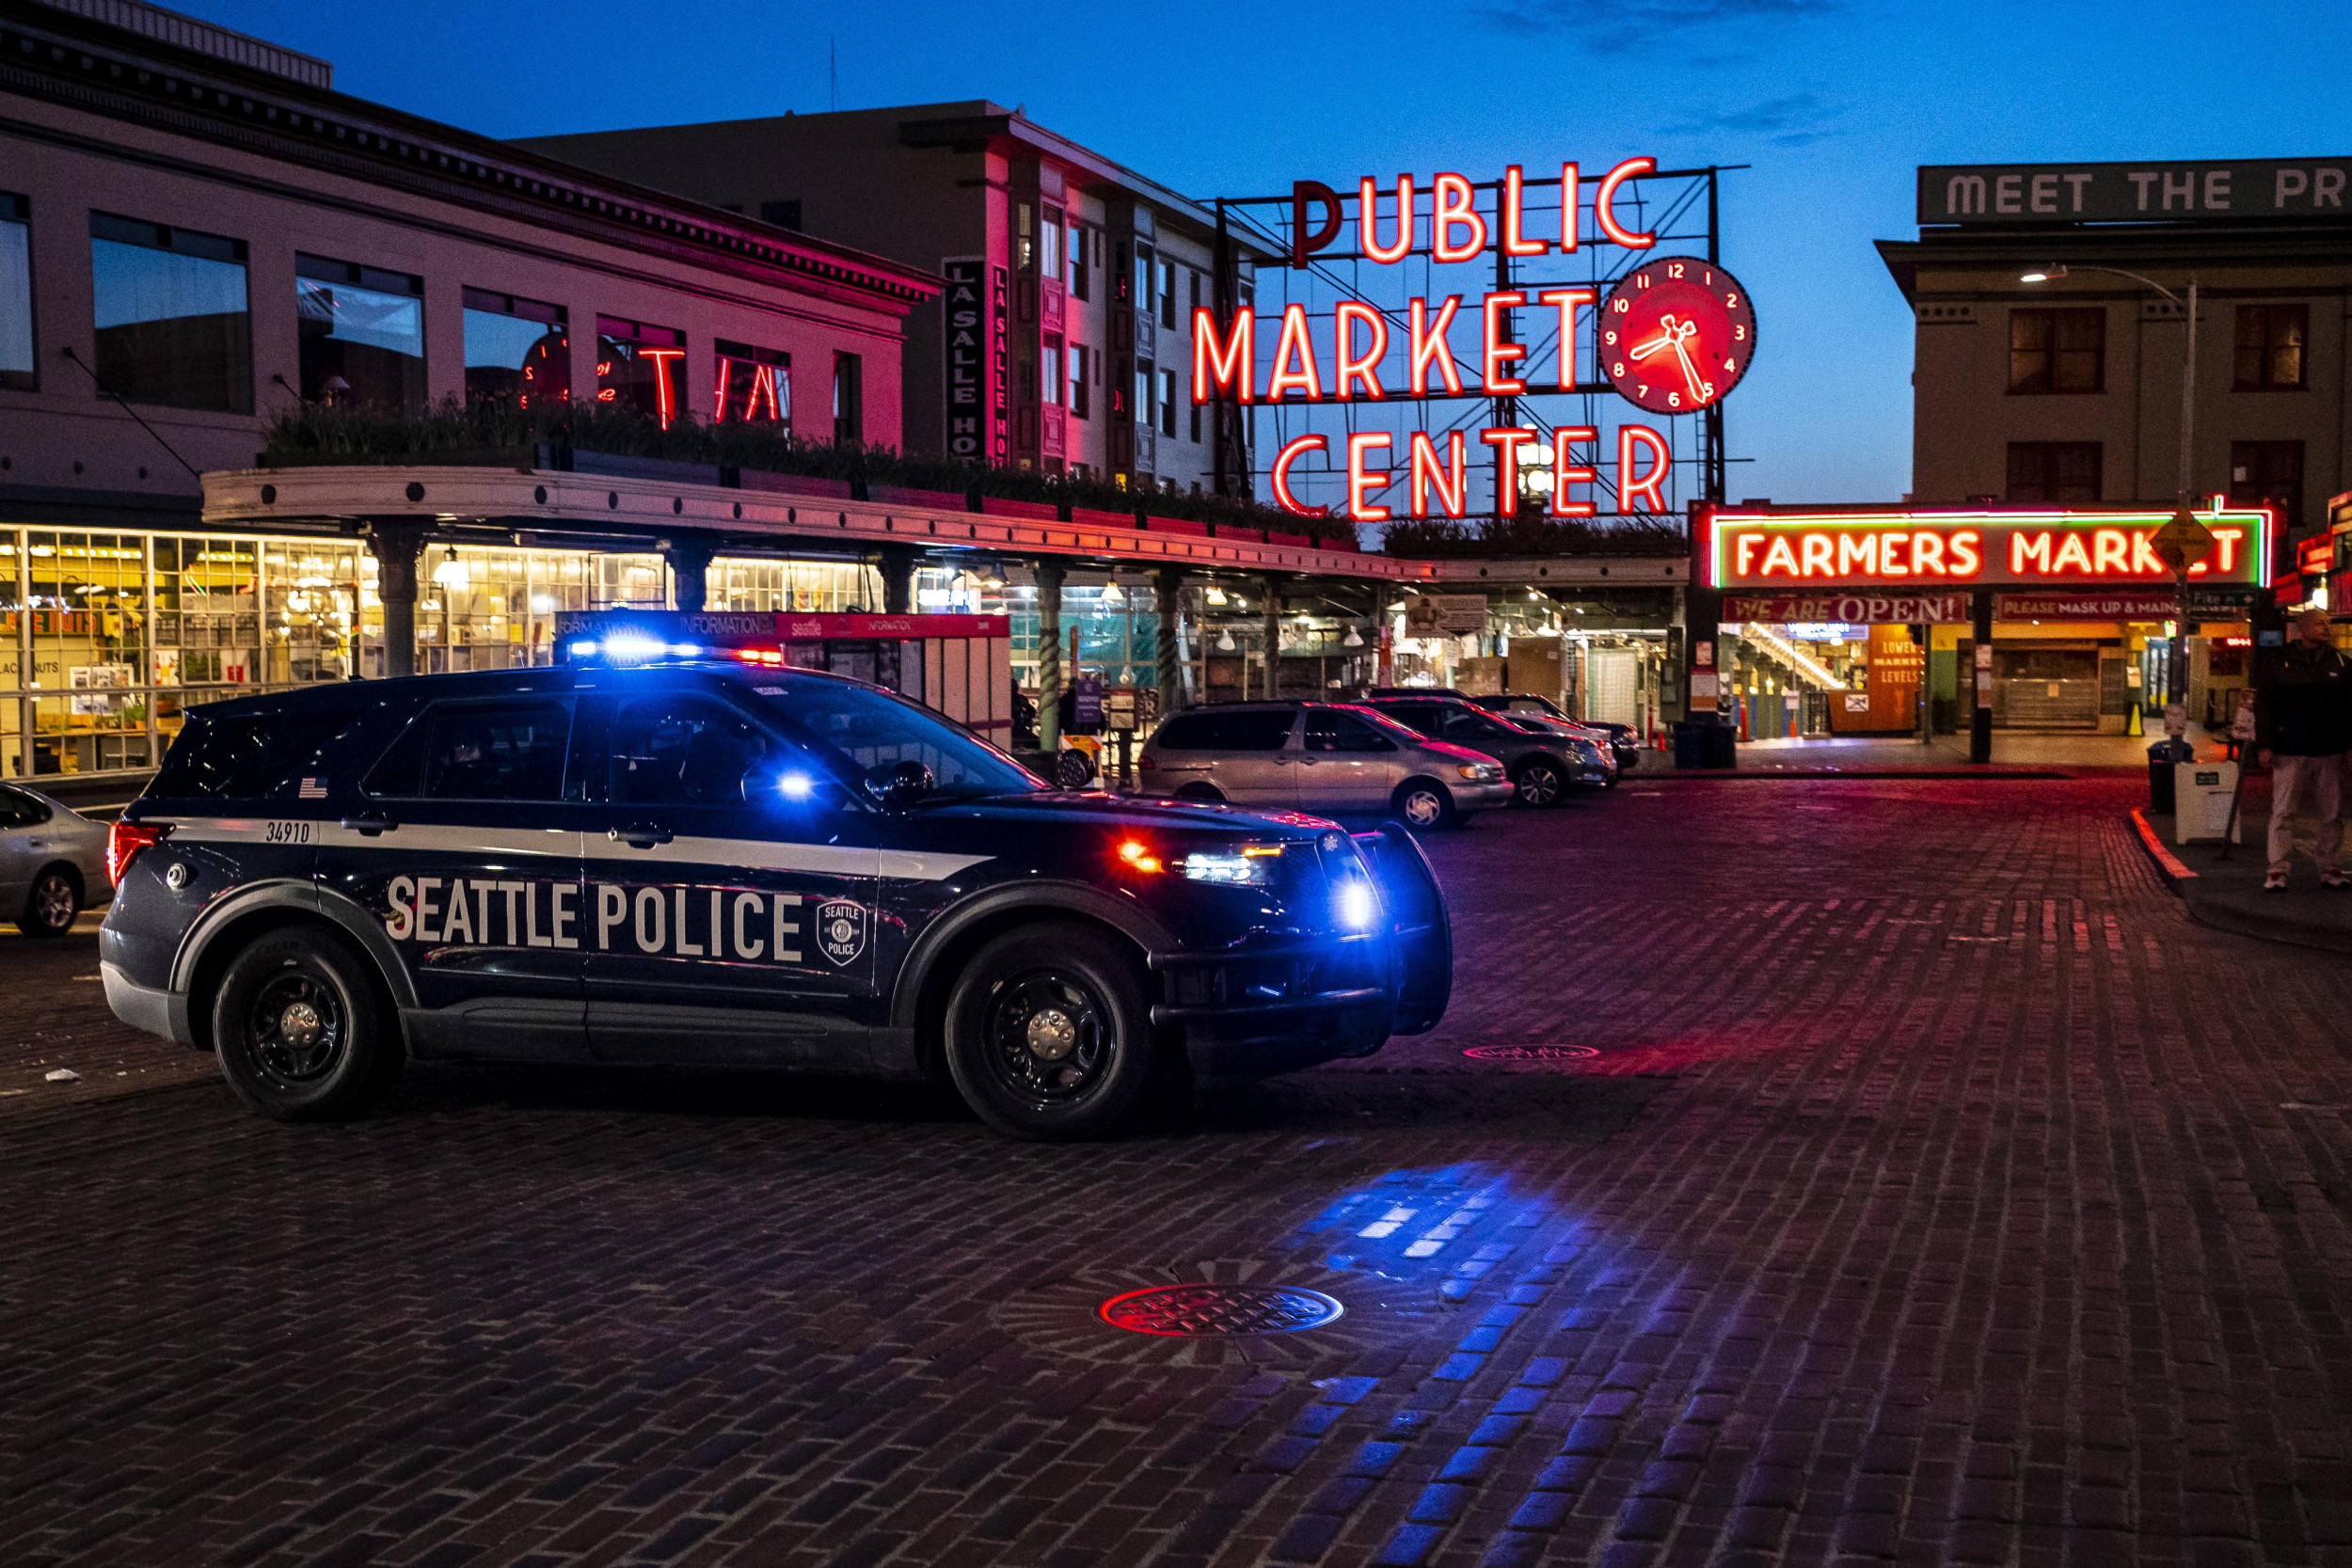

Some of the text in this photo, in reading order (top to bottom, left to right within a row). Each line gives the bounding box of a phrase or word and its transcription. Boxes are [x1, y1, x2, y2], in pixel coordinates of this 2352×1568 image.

[1947, 174, 2092, 214] MEET
[2128, 170, 2232, 212] THE
[1293, 157, 1657, 269] PUBLIC
[1668, 263, 1685, 278] 12
[1637, 274, 1649, 289] 11
[1705, 271, 1711, 286] 1
[1613, 298, 1629, 313] 10
[1726, 293, 1738, 309] 2
[1605, 330, 1617, 345] 9
[1734, 325, 1745, 341] 3
[1192, 288, 1597, 404] MARKET
[952, 310, 977, 404] SALLE
[1724, 357, 1736, 372] 4
[1613, 362, 1625, 377] 8
[1637, 385, 1648, 399] 7
[1668, 391, 1680, 407] 6
[1272, 425, 1670, 522] CENTER
[1737, 530, 2243, 576] FARMERS MARKT
[1736, 596, 1955, 622] WE ARE OPEN!
[2004, 602, 2057, 614] PLEASE
[2058, 601, 2099, 614] MASK
[2102, 602, 2122, 613] UP
[2124, 602, 2136, 613] &
[679, 615, 760, 634] INFORMATION
[1883, 641, 1917, 654] LOWER
[1882, 670, 1918, 683] LEVELS
[266, 822, 310, 843] 34910
[387, 876, 803, 961] SEATTLE POLICE
[825, 906, 859, 920] SEATTLE
[828, 942, 854, 955] POLICE
